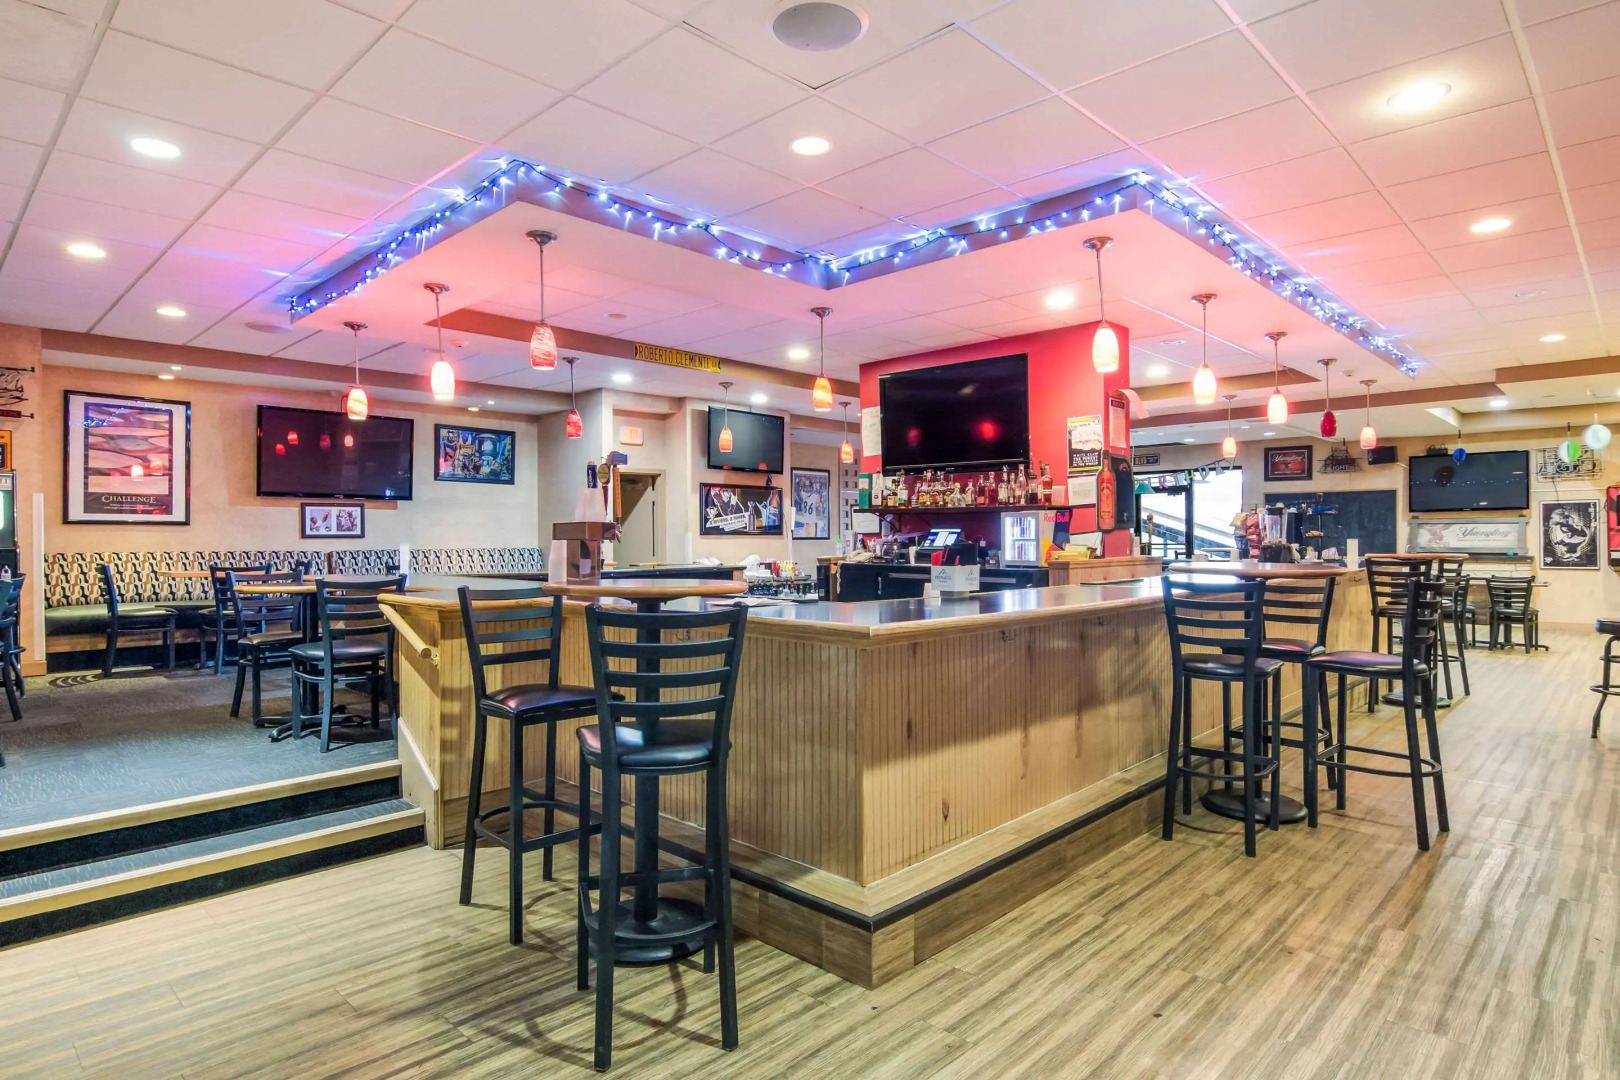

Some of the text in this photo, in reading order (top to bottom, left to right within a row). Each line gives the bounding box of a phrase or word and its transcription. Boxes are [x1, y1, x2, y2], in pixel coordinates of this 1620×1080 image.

[638, 345, 674, 364] ROBERTO
[675, 351, 711, 370] CLEMENTE
[1136, 458, 1237, 489] IRTHDAY
[101, 495, 156, 503] CHALLENGE
[803, 501, 814, 515] 86
[1043, 511, 1069, 522] Red Bull
[1457, 525, 1513, 539] Yuengling
